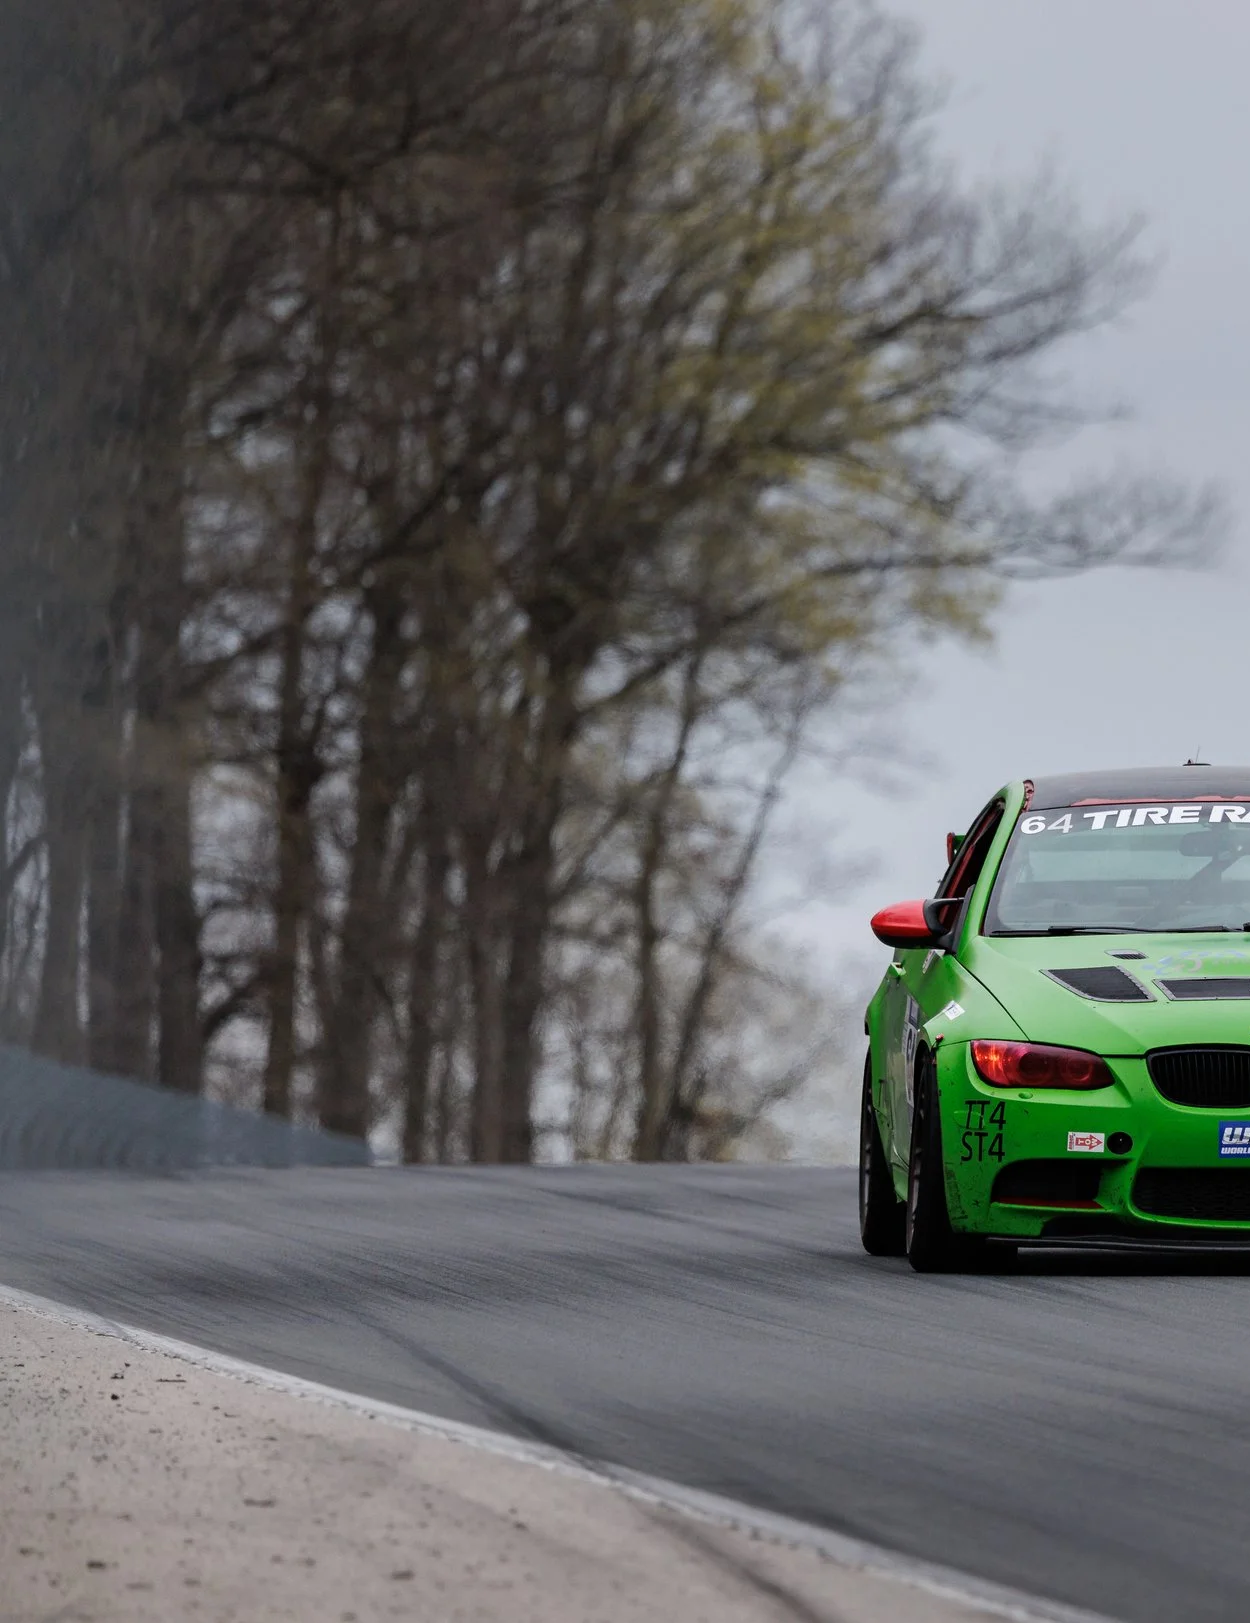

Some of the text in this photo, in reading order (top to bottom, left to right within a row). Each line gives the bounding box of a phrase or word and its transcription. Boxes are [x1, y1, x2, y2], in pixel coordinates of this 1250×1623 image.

[1020, 815, 1073, 835] 64
[1083, 806, 1203, 831] TIRE
[965, 1100, 1006, 1131] TT4
[961, 1131, 1005, 1163] ST4
[1077, 1137, 1098, 1147] TOW
